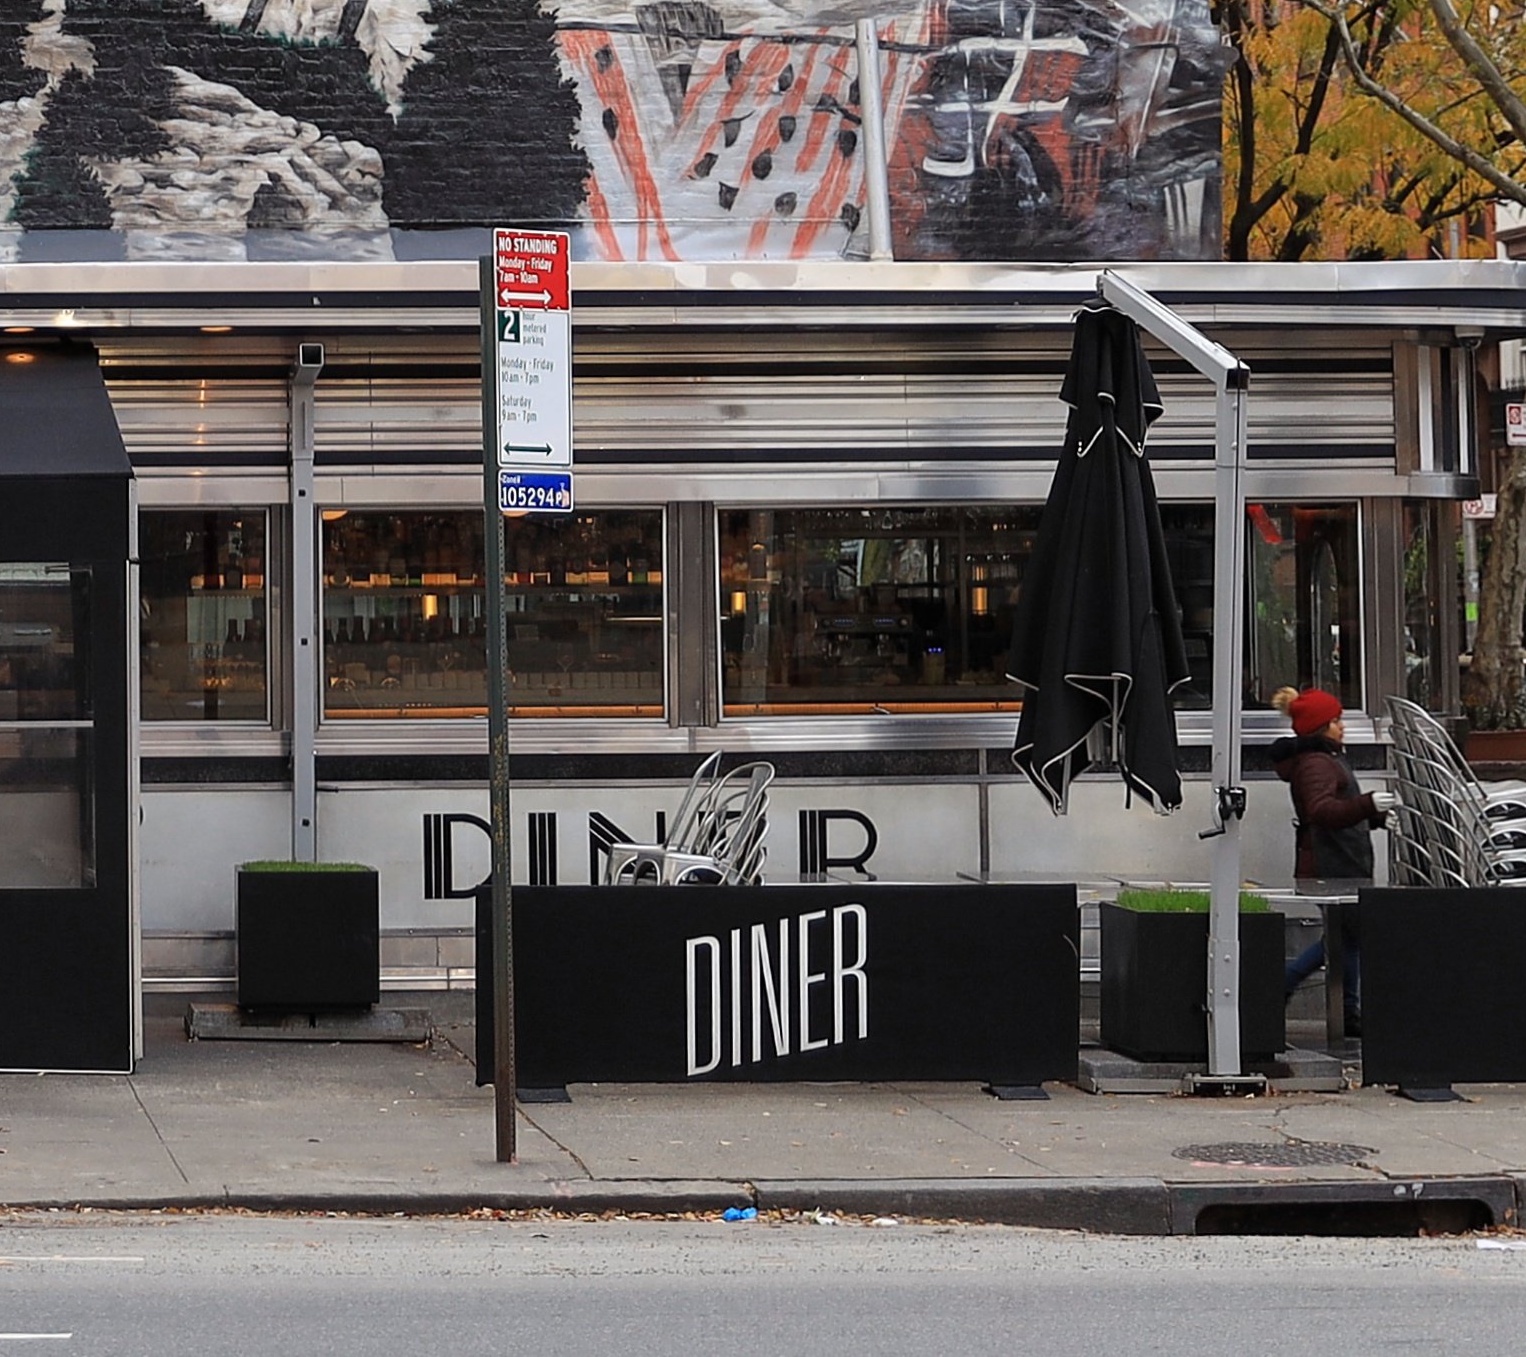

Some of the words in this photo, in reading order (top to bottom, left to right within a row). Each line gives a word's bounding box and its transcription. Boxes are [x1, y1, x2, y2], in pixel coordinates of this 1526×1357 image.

[498, 236, 512, 252] NO
[513, 238, 557, 254] STANDING
[499, 255, 526, 270] Monday
[531, 257, 552, 272] Friday
[499, 271, 515, 283] 7am
[520, 272, 538, 284] 10am
[503, 310, 516, 340] 2
[501, 356, 527, 370] Monday
[533, 358, 554, 372] Friday
[501, 371, 519, 383] 10am
[502, 394, 531, 407] Saturday
[502, 486, 554, 507] 105294
[685, 902, 869, 1077] DINER
